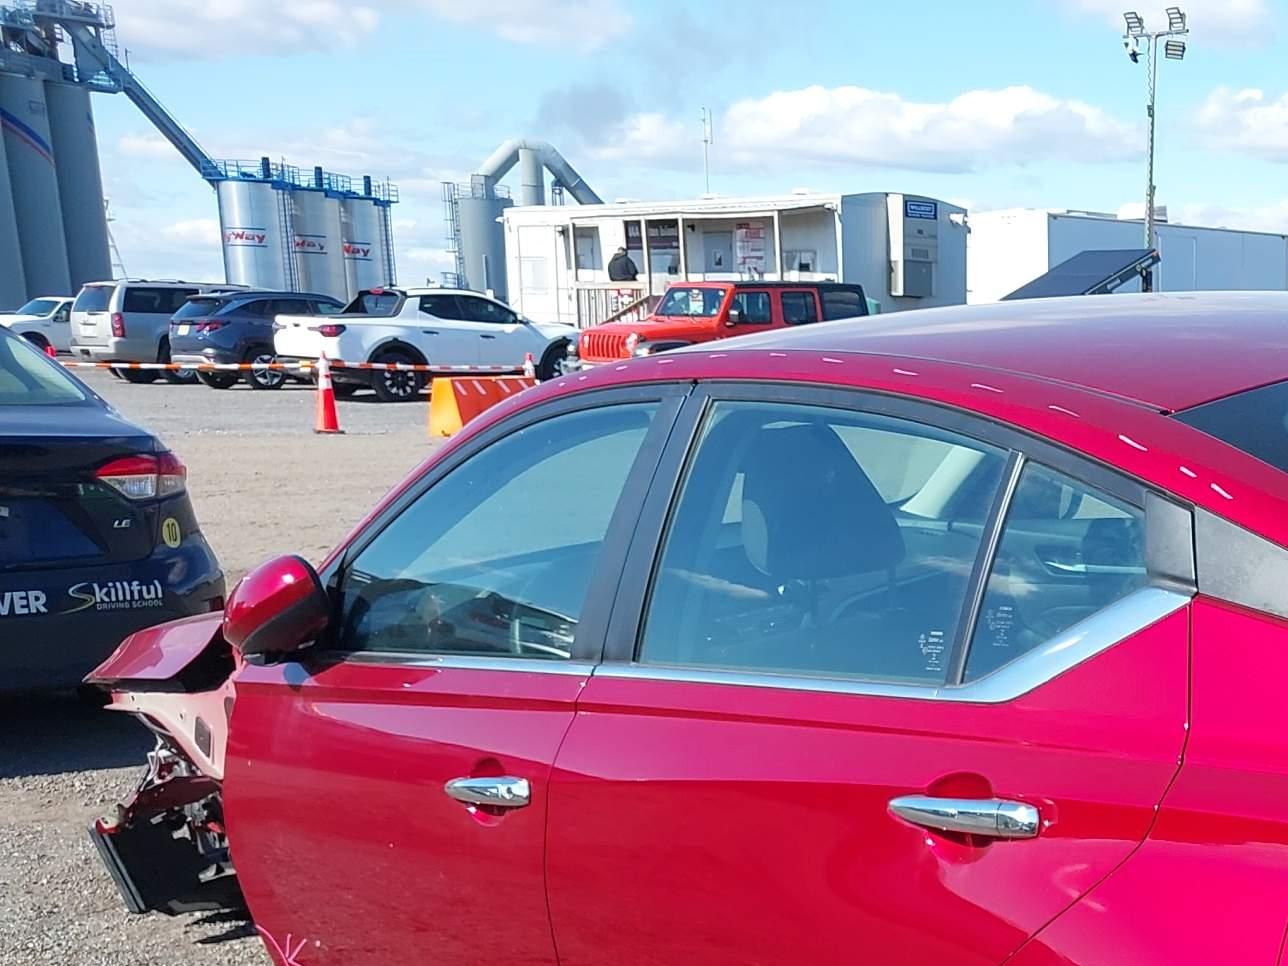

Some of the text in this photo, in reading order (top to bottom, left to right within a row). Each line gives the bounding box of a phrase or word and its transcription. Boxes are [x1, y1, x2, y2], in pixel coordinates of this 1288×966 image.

[113, 519, 131, 528] LE
[166, 520, 177, 542] 10
[58, 579, 163, 615] Skillful
[96, 600, 163, 610] DRIVING SCHOOL
